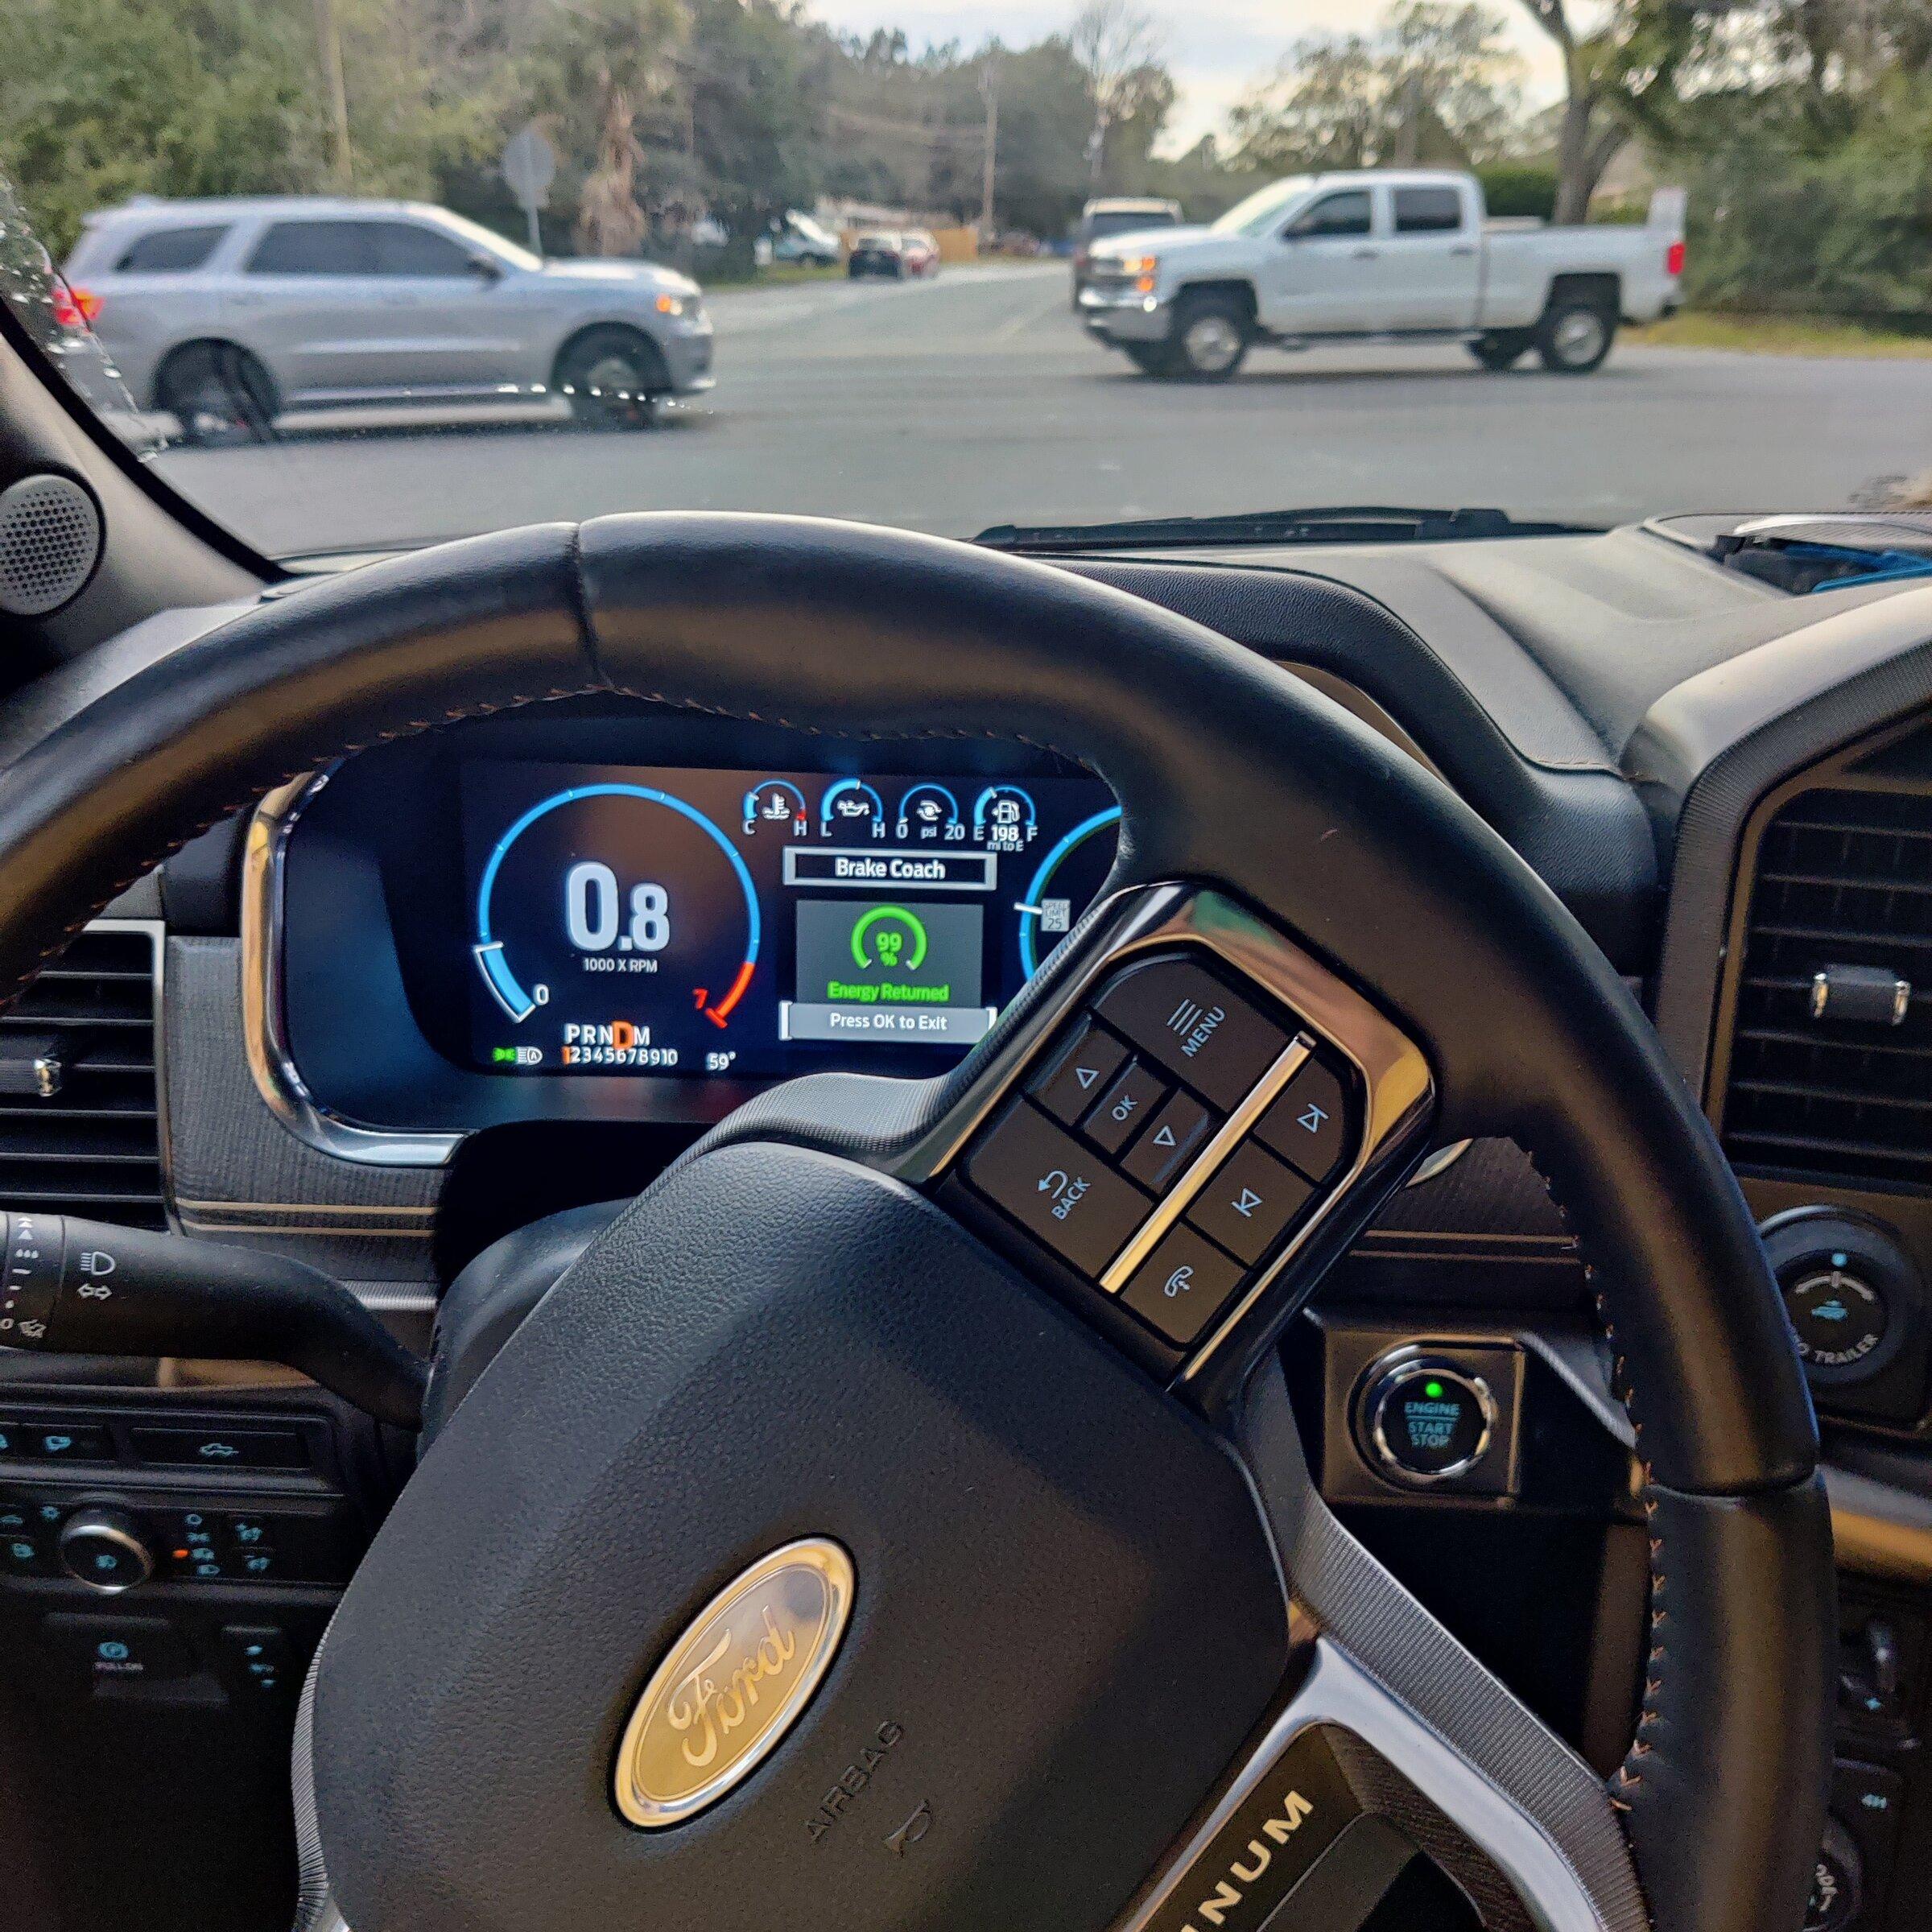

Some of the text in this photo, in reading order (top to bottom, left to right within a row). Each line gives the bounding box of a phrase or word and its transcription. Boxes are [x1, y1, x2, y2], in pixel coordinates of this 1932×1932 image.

[742, 819, 756, 835] C
[794, 820, 807, 836] H
[819, 822, 832, 837] L
[872, 822, 886, 838] H
[920, 825, 937, 839] psi
[944, 824, 965, 840] 20
[973, 825, 985, 840] E
[991, 824, 1019, 841] 198
[1026, 825, 1038, 842] F
[1002, 840, 1014, 852] to
[1015, 838, 1024, 852] E
[835, 857, 946, 879] Brake Coach
[567, 861, 671, 952] 0.8
[1047, 918, 1062, 930] 25
[876, 931, 902, 952] 99
[584, 958, 658, 972] 1000 X RPM
[533, 984, 549, 1005] 0
[693, 988, 708, 1010] 7
[827, 980, 950, 1002] Energy Returned
[830, 1013, 947, 1030] Press OK to Exit
[1180, 1005, 1226, 1058] MENU
[1112, 1096, 1138, 1121] OK
[1051, 1176, 1092, 1220] BACK
[1814, 1333, 1879, 1364] TRAILER
[1403, 1402, 1461, 1416] ENGINE
[1409, 1422, 1455, 1435] START
[1410, 1434, 1451, 1447] STOP
[668, 1604, 795, 1767] Ford
[807, 1720, 903, 1844] AIRBAG
